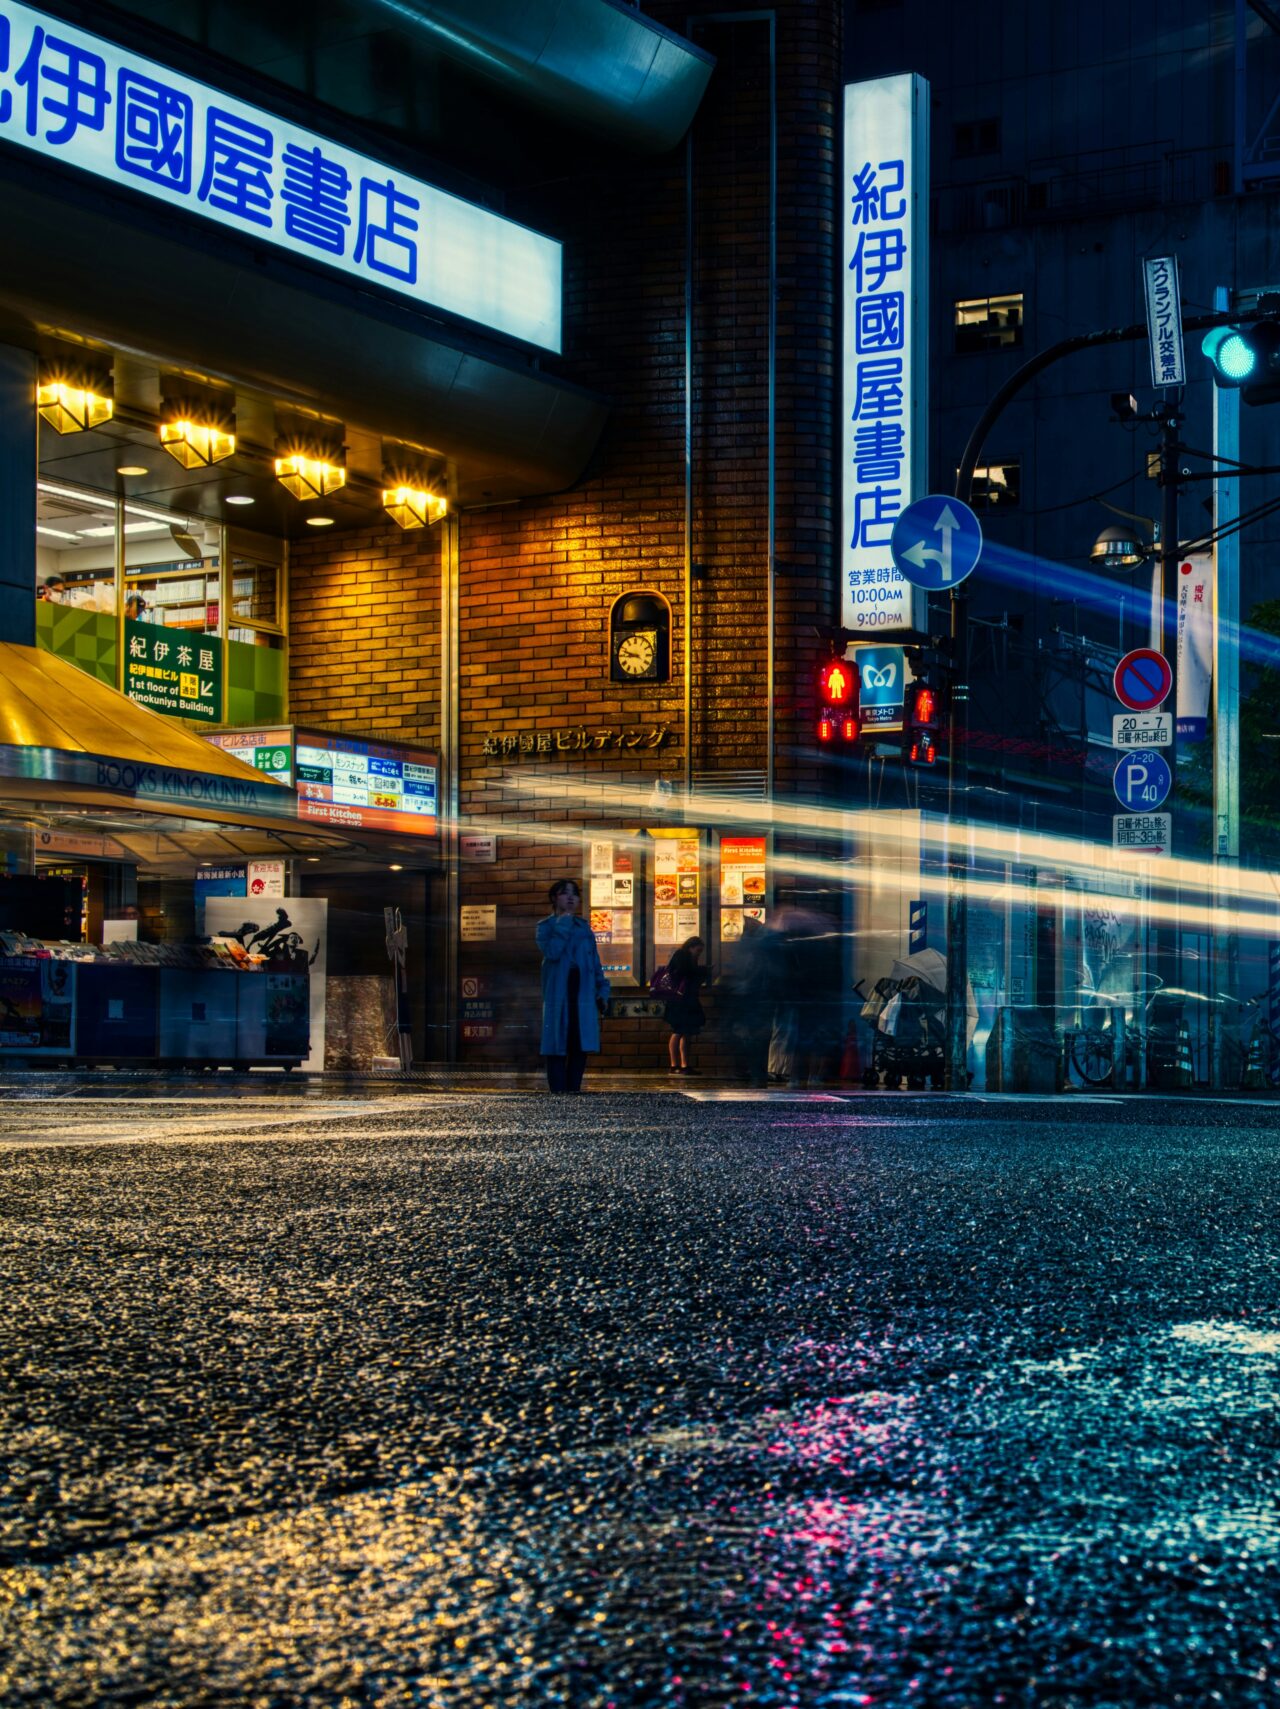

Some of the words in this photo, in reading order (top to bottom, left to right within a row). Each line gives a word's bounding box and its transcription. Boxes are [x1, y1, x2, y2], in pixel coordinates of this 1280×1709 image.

[1153, 261, 1177, 381] スクランブル交差点
[848, 159, 907, 551] 紀伊國屋書店
[848, 566, 904, 587] 営業時間
[850, 587, 903, 604] 10:00AM
[857, 611, 903, 627] 9:00PM
[130, 635, 214, 671] 紀伊茶屋
[129, 677, 145, 690] 1st
[147, 681, 168, 694] floor
[170, 686, 179, 696] of
[128, 690, 177, 708] Kinokuniya
[179, 699, 214, 716] Building
[865, 708, 894, 717] 東京メトロ
[1122, 718, 1137, 730] 20
[1155, 716, 1163, 729] 7
[483, 728, 667, 756] 紀伊國屋ビルディング
[1131, 753, 1154, 764] 7-20
[97, 761, 157, 793] BOOKS
[162, 773, 259, 808] KINOKUNIYA
[1127, 764, 1149, 802] P
[1141, 784, 1157, 802] 40
[308, 805, 328, 816] First
[329, 808, 363, 820] Kitchen
